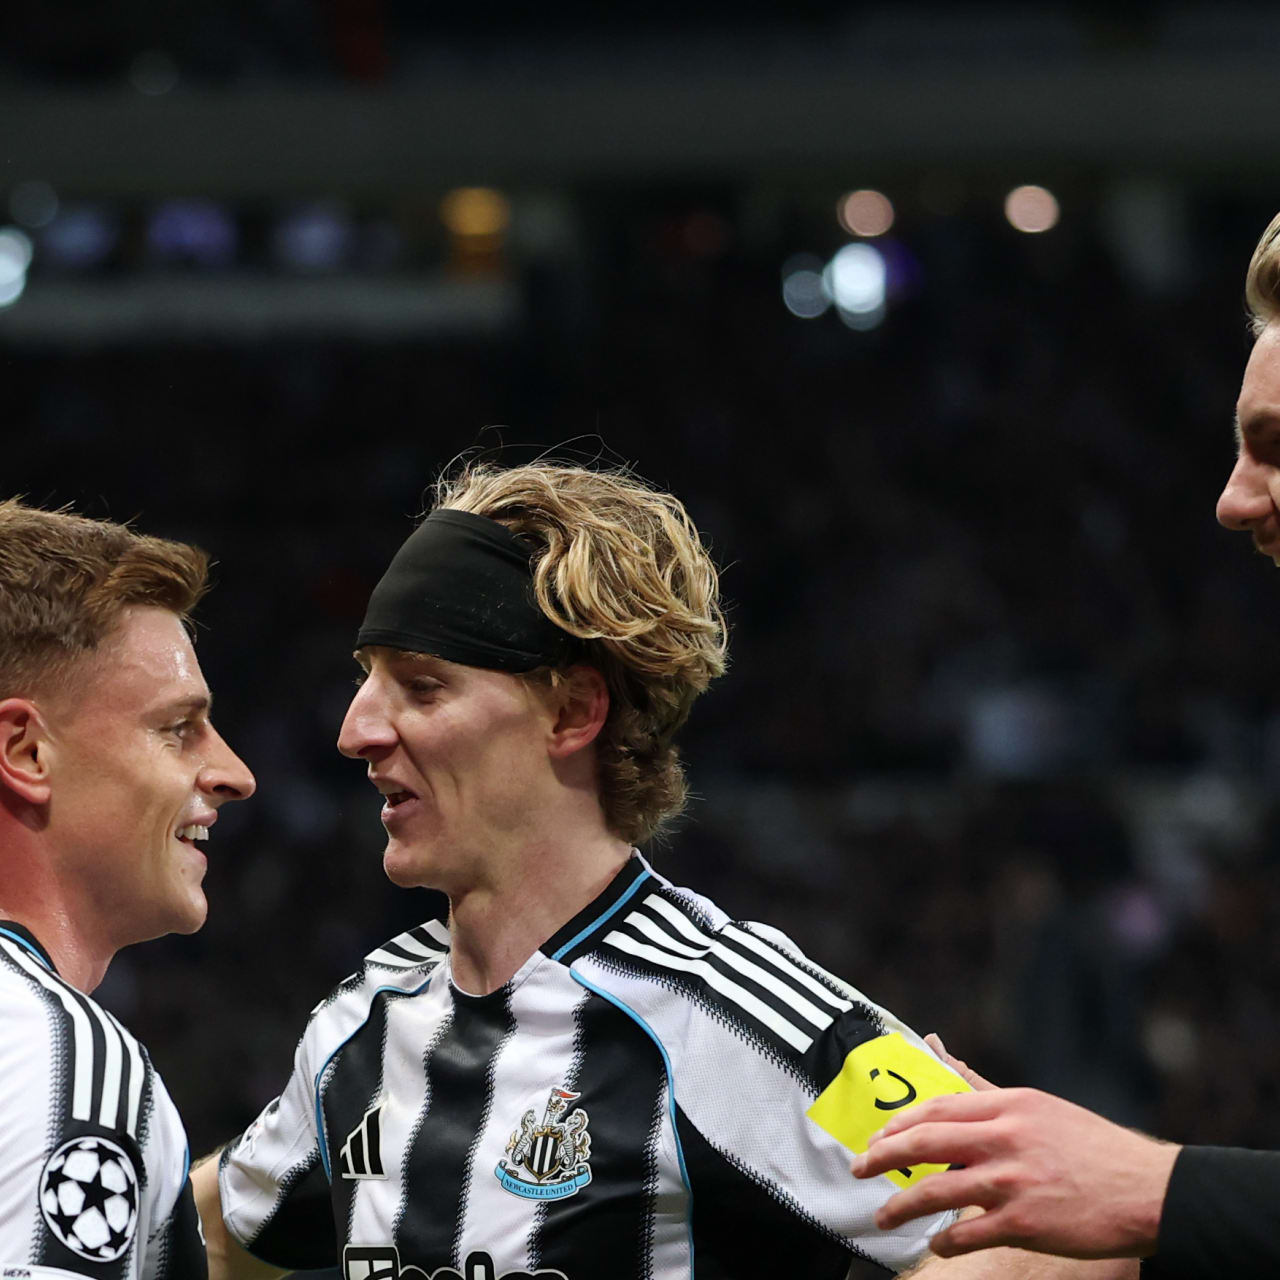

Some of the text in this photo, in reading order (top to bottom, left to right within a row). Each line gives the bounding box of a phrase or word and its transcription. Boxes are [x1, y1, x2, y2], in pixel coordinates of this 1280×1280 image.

[505, 1180, 573, 1196] NEWCASTLE UNITED
[4, 1269, 31, 1278] UEFA
